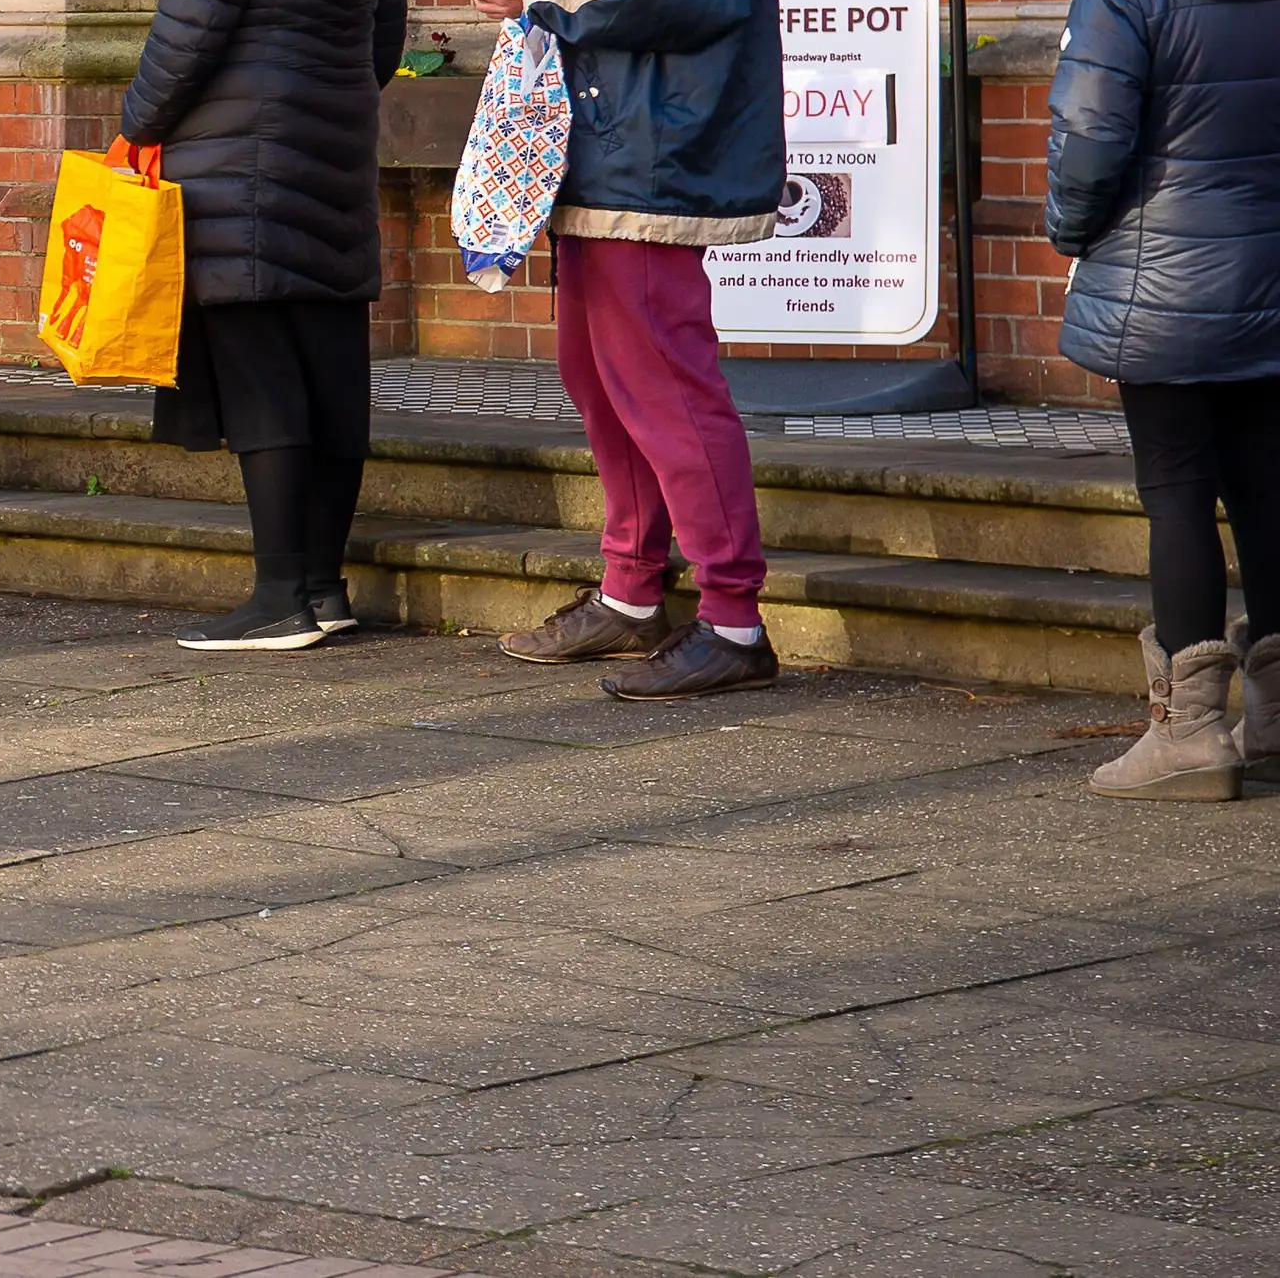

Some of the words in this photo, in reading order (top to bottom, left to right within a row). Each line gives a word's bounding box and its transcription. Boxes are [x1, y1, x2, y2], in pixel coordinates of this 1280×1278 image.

[847, 6, 909, 33] POT
[782, 52, 828, 63] Broadway
[829, 52, 862, 63] Baptist
[782, 88, 874, 118] ODAY
[797, 153, 815, 165] TO
[819, 153, 833, 165] 12
[837, 153, 877, 165] NOON
[707, 249, 719, 262] A
[721, 251, 762, 262] warm
[765, 249, 791, 263] and
[795, 249, 851, 265] friendly
[853, 249, 918, 263] welcome
[719, 274, 745, 287] and
[748, 277, 757, 287] a
[760, 274, 810, 288] chance
[813, 276, 829, 288] to
[832, 274, 871, 288] make
[873, 277, 905, 288] new
[786, 298, 835, 313] friends
